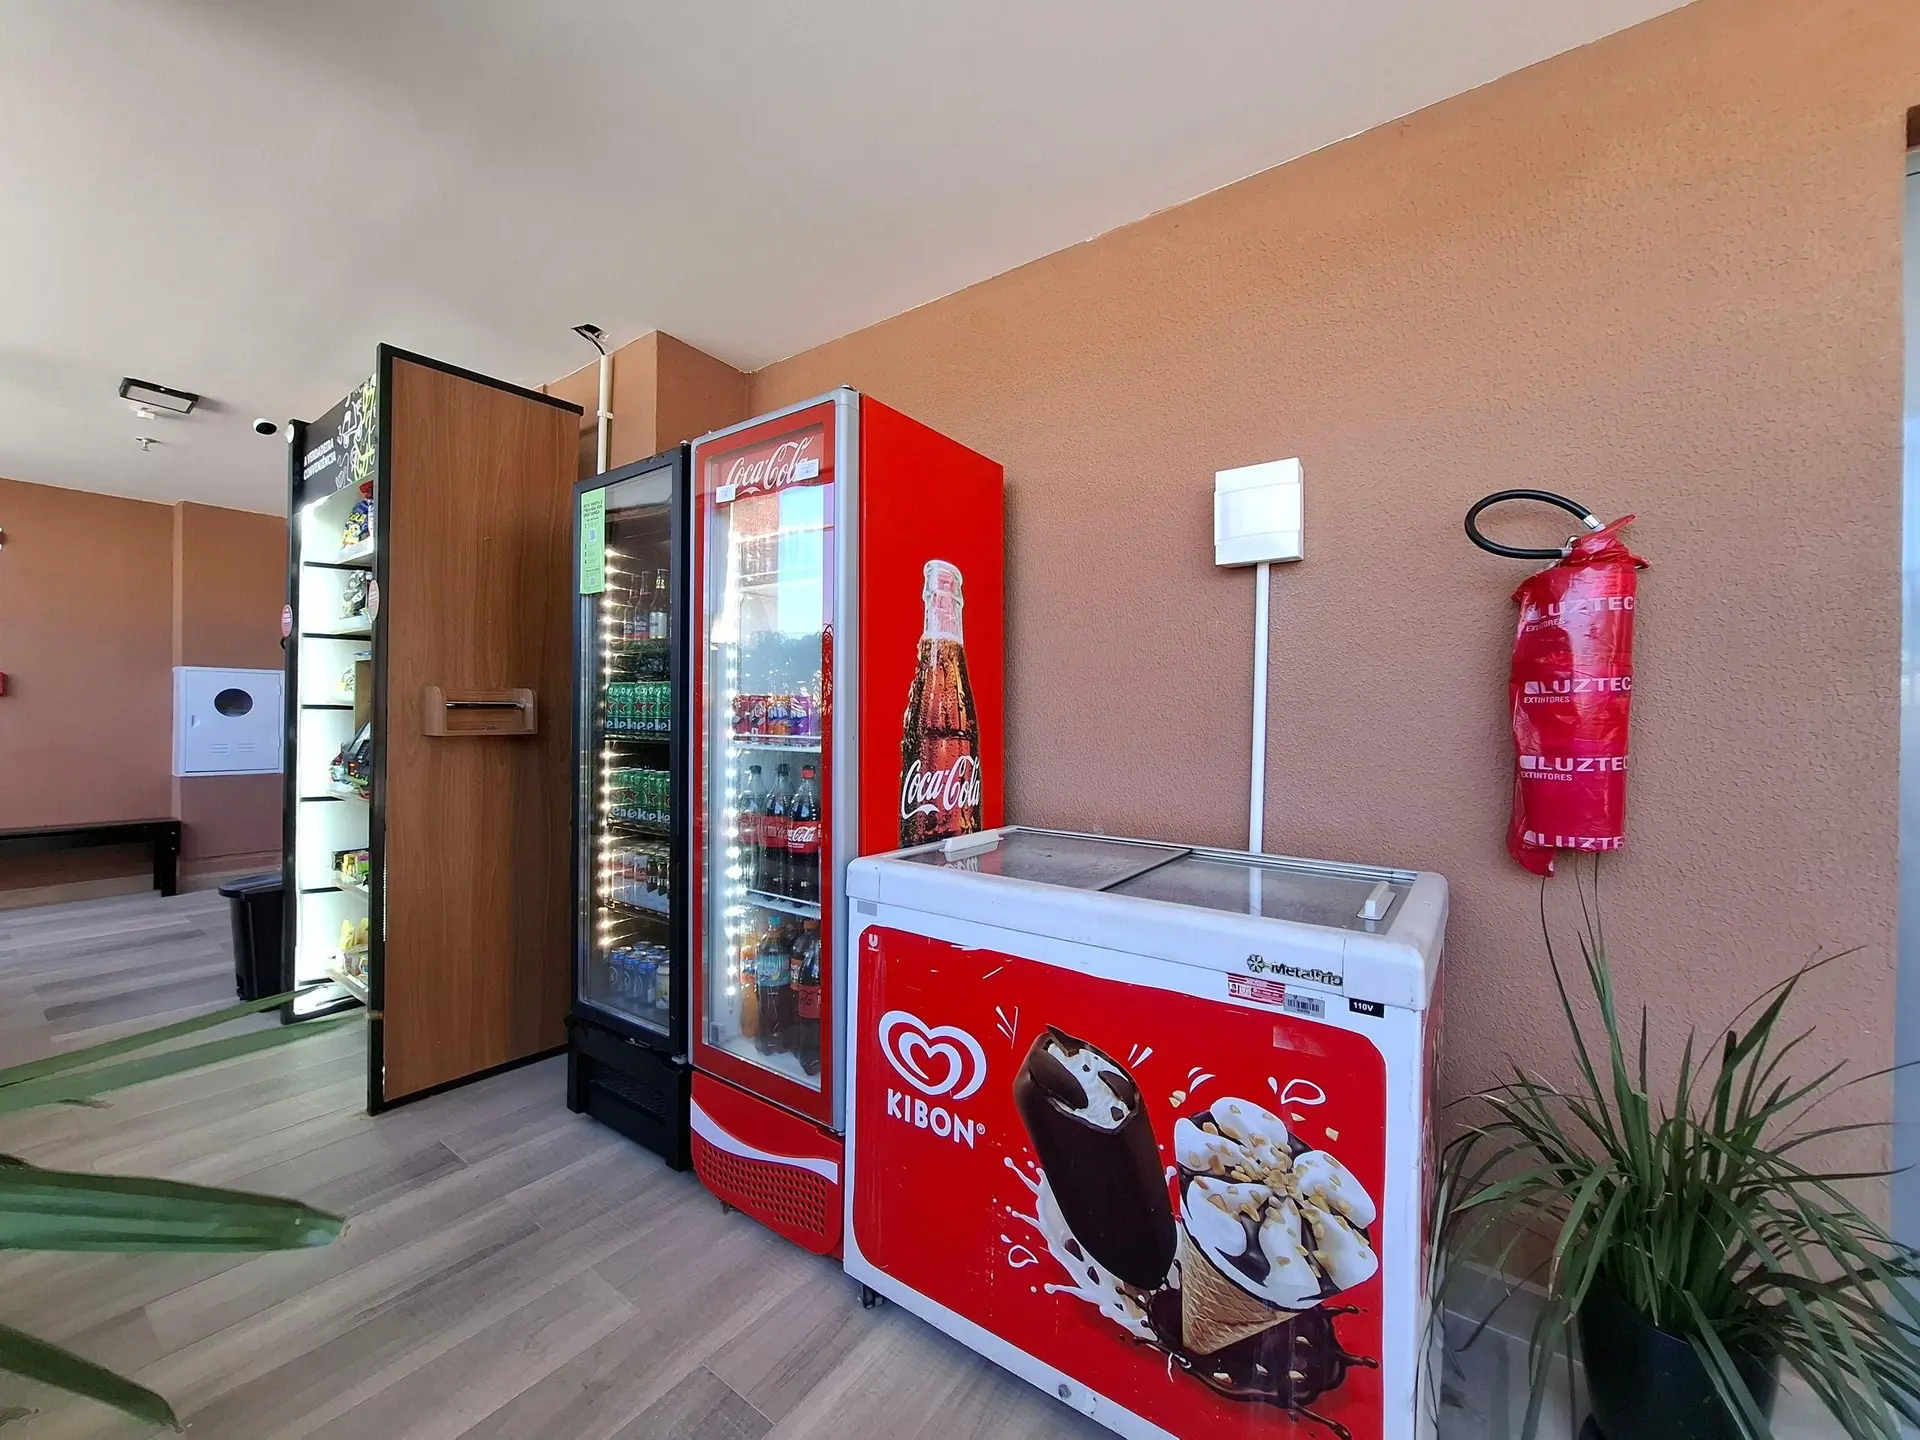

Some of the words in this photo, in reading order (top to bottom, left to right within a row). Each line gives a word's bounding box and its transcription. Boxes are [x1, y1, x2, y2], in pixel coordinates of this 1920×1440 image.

[725, 436, 813, 495] Coca-Col
[1541, 596, 1634, 619] UZTEC
[1540, 677, 1632, 694] LUZTEC
[1523, 695, 1570, 704] EXTINTORES
[1521, 771, 1573, 782] EXTINTORES
[1353, 1001, 1374, 1012] 110V
